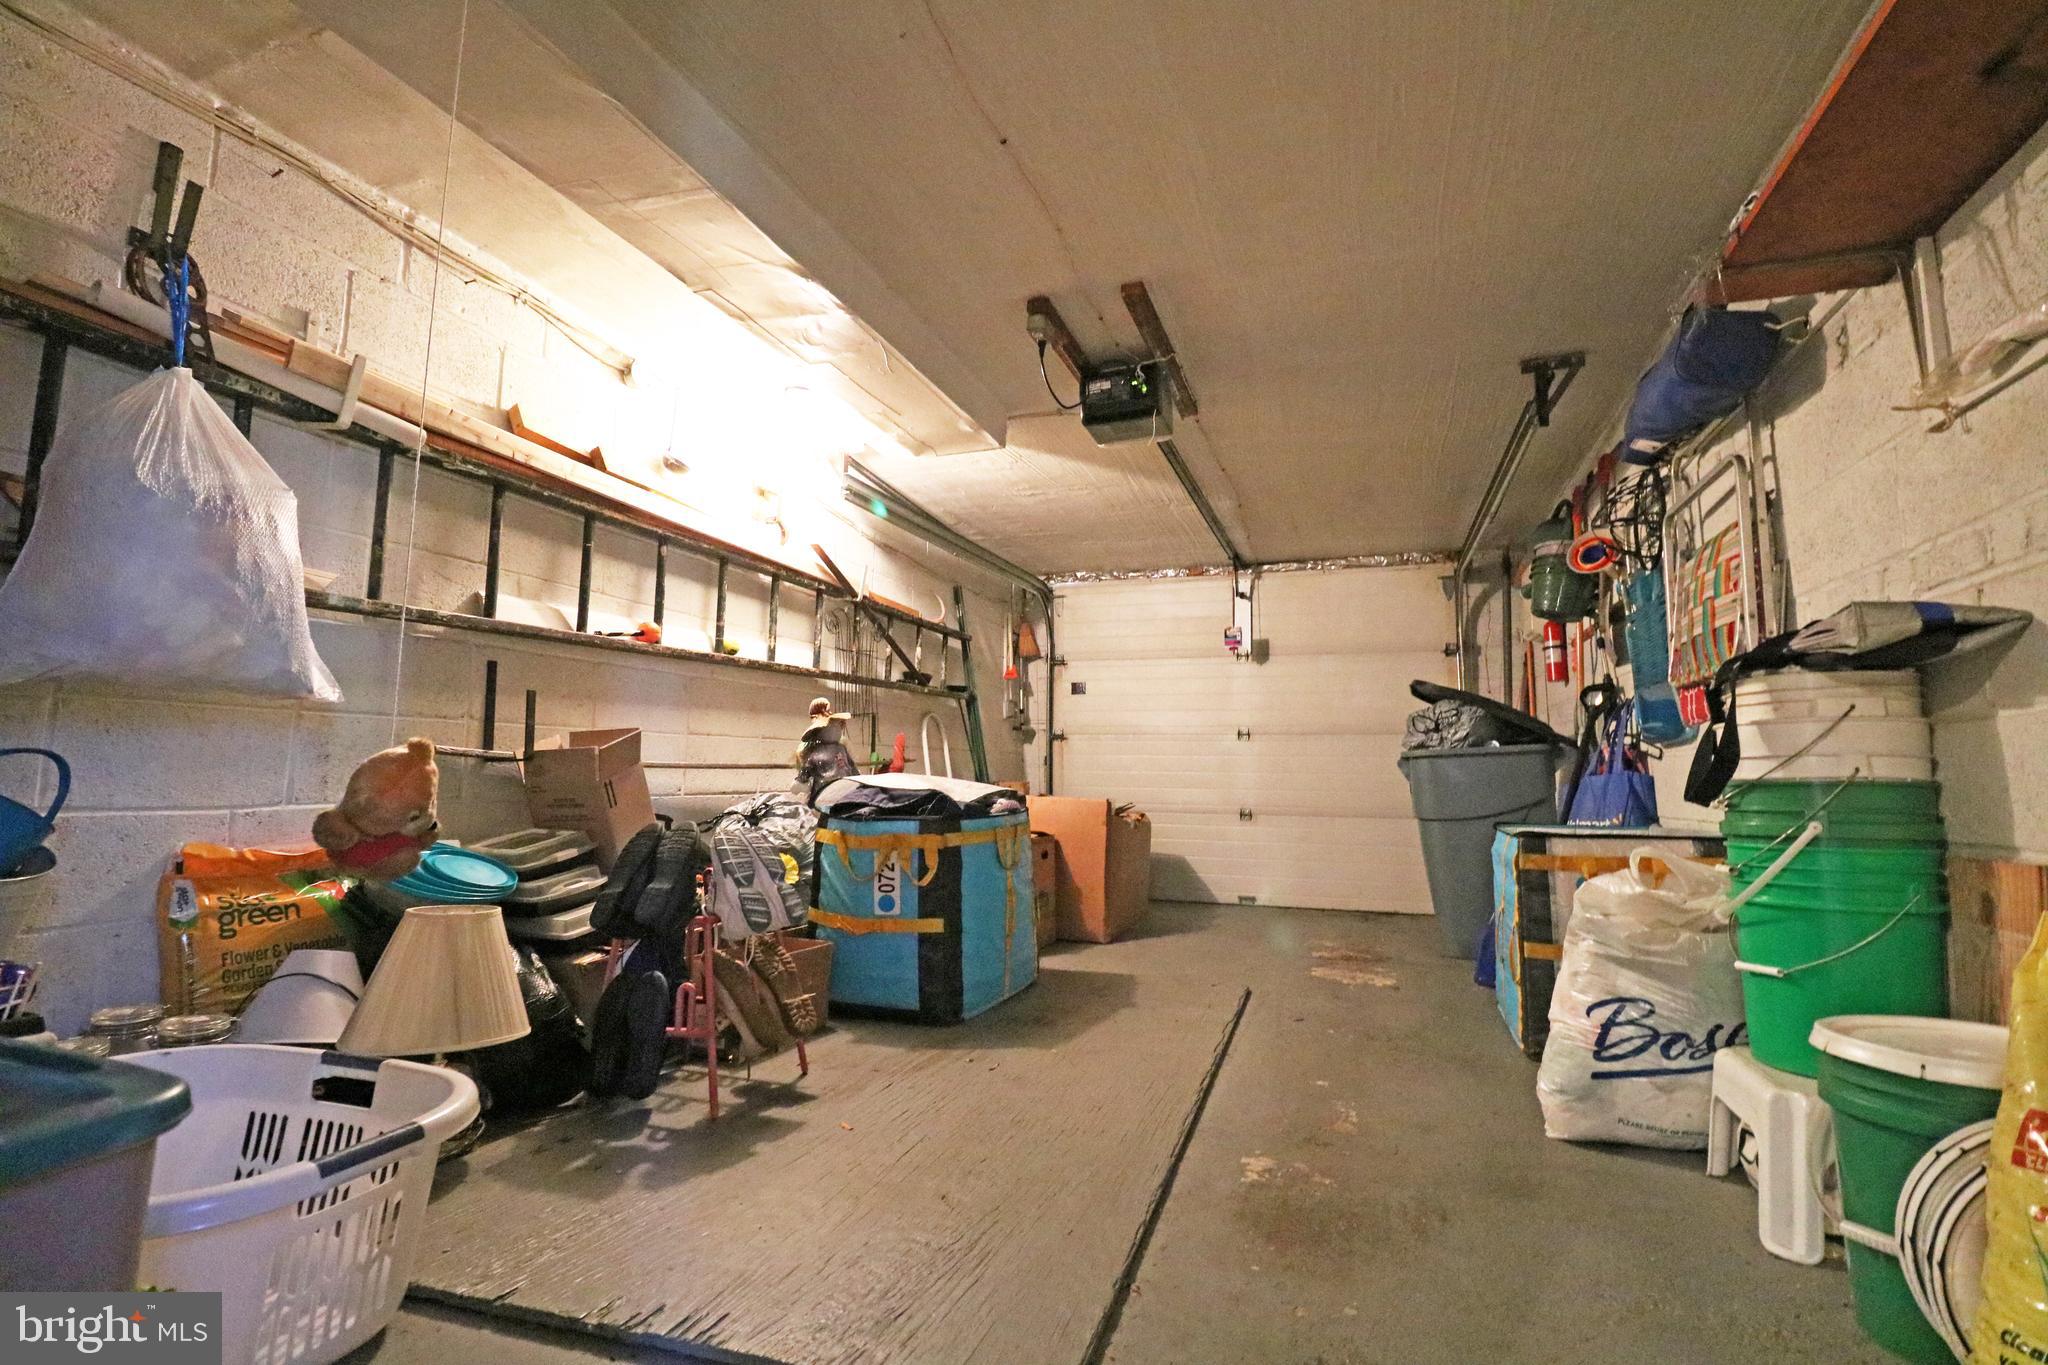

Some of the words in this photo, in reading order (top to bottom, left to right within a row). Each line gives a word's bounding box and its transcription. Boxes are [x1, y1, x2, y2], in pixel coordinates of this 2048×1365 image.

[218, 902, 301, 940] green
[221, 949, 269, 968] Flower
[273, 943, 282, 958] &
[222, 963, 274, 983] Garden
